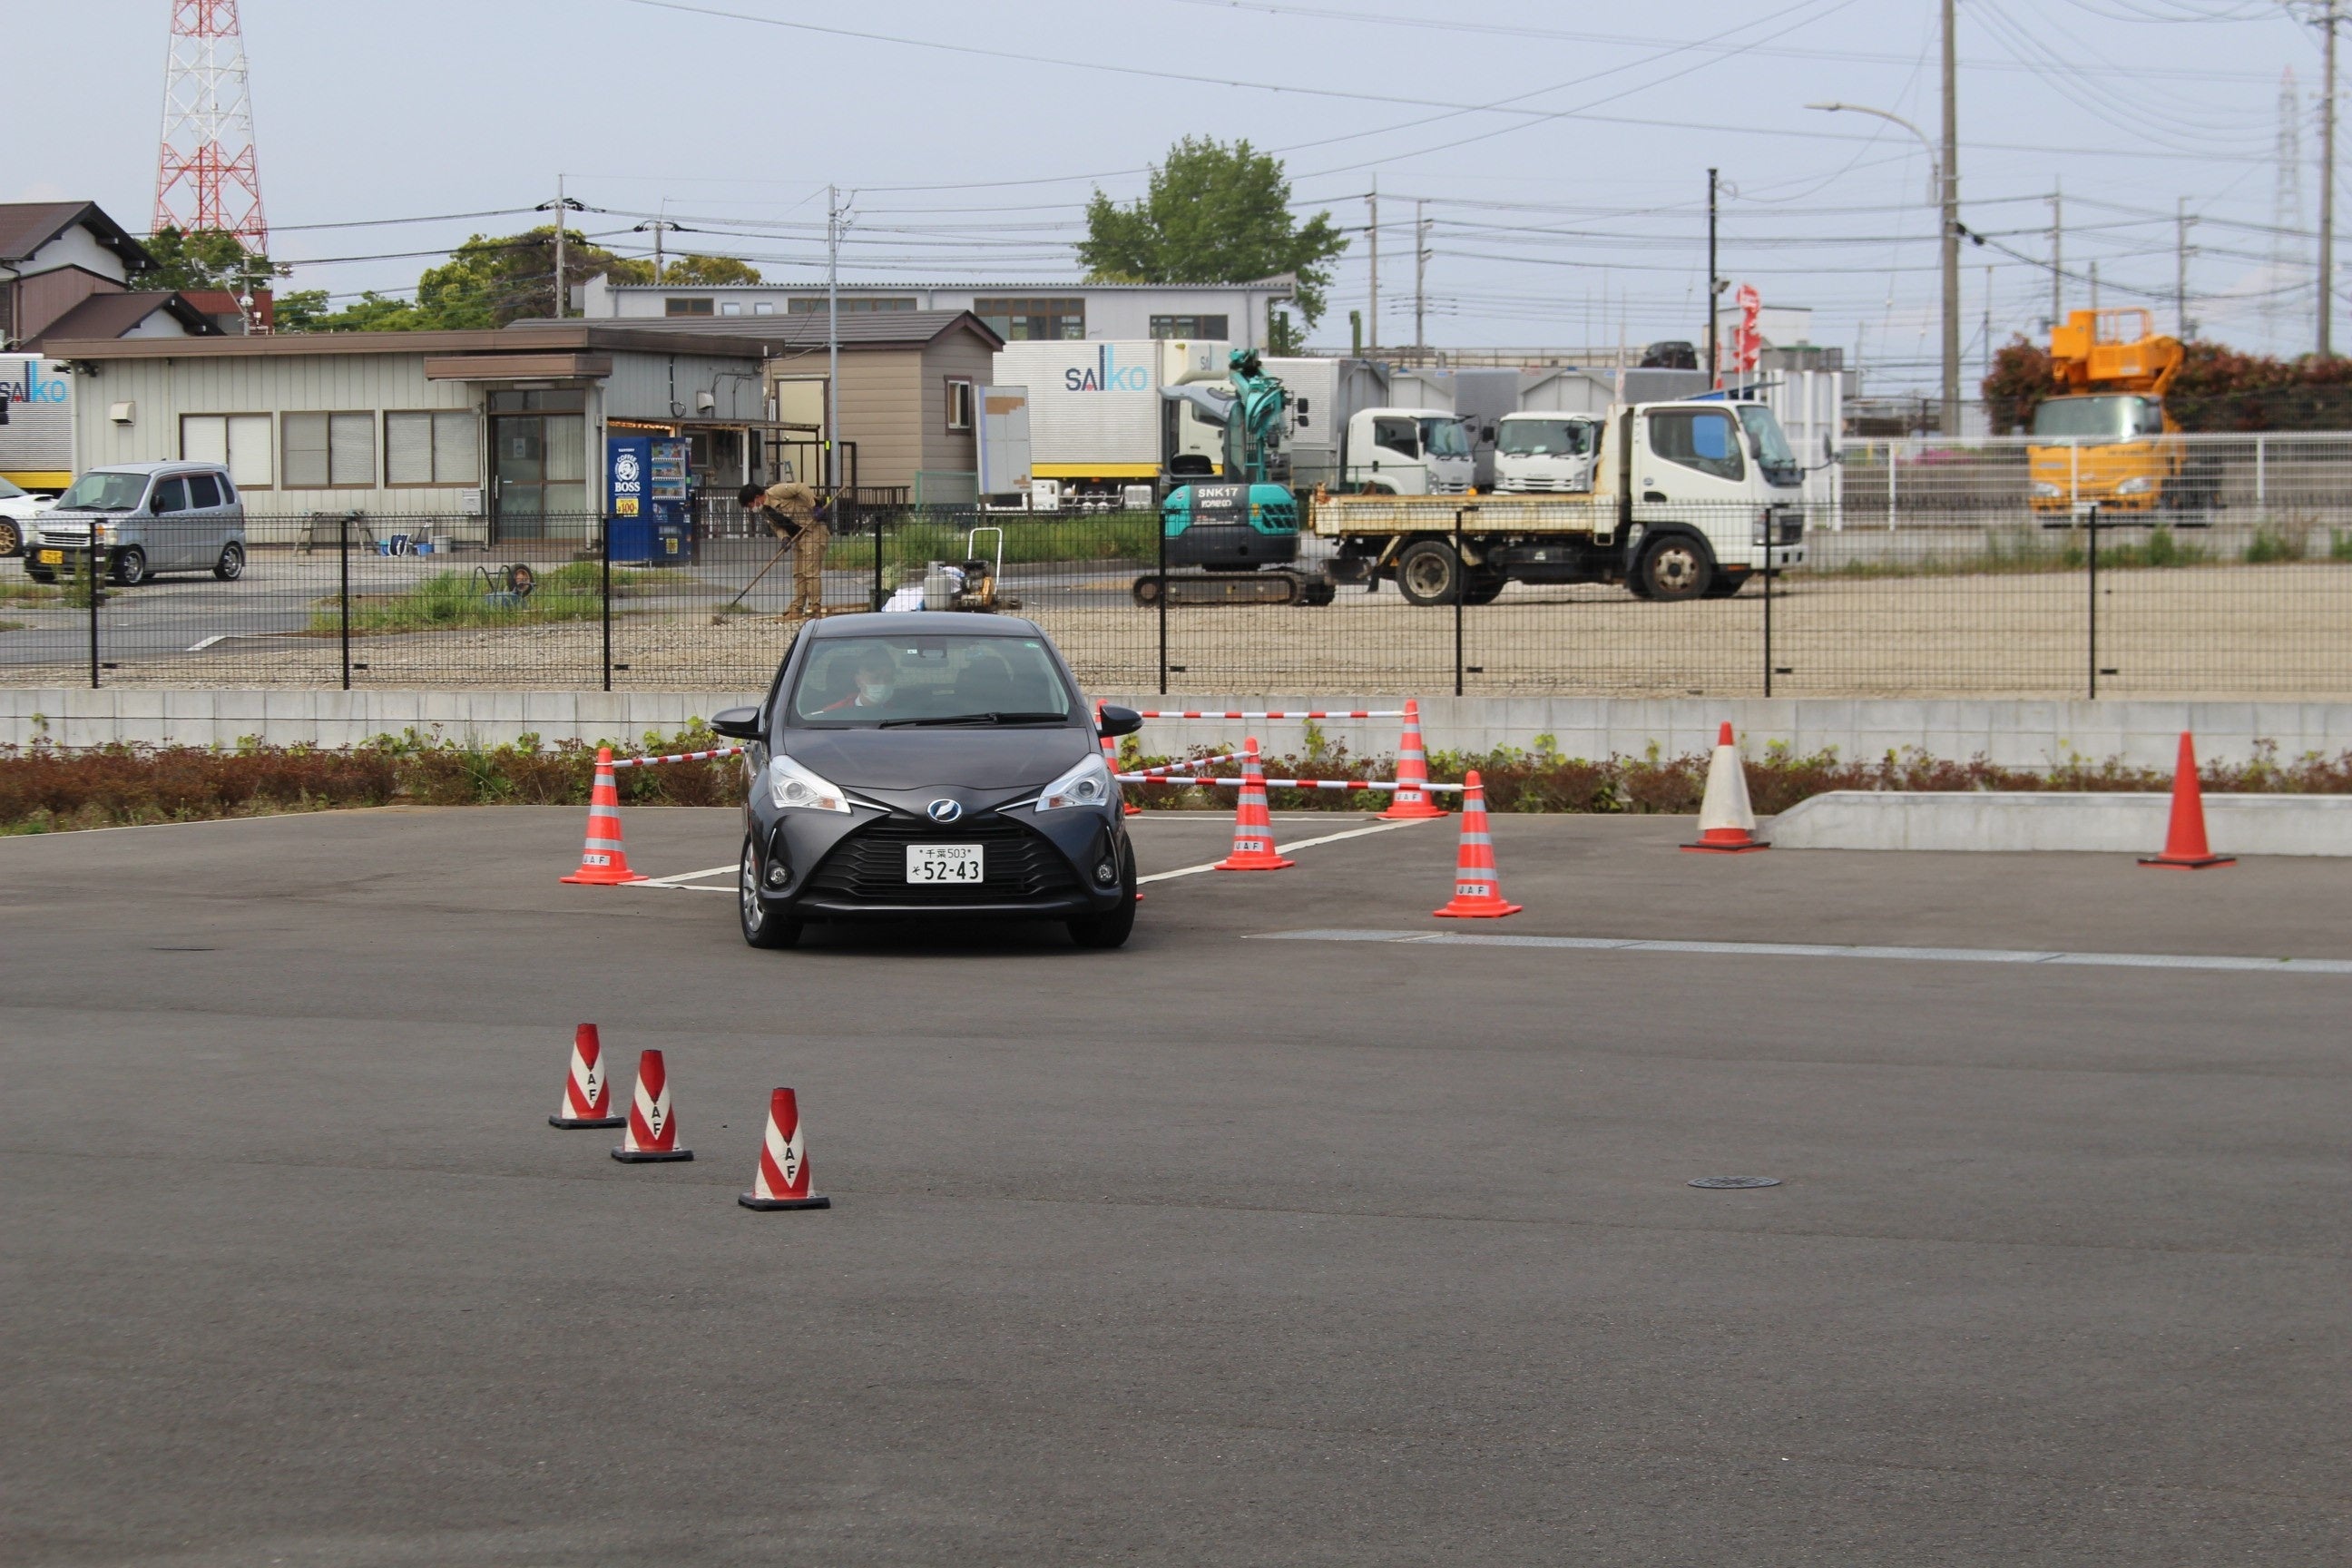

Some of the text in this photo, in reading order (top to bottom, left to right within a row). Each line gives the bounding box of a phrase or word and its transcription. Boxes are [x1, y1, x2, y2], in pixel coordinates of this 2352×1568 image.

[614, 482, 641, 493] BOSS
[583, 856, 605, 864] JAF
[925, 861, 979, 880] 52-43
[1458, 886, 1484, 895] JAF
